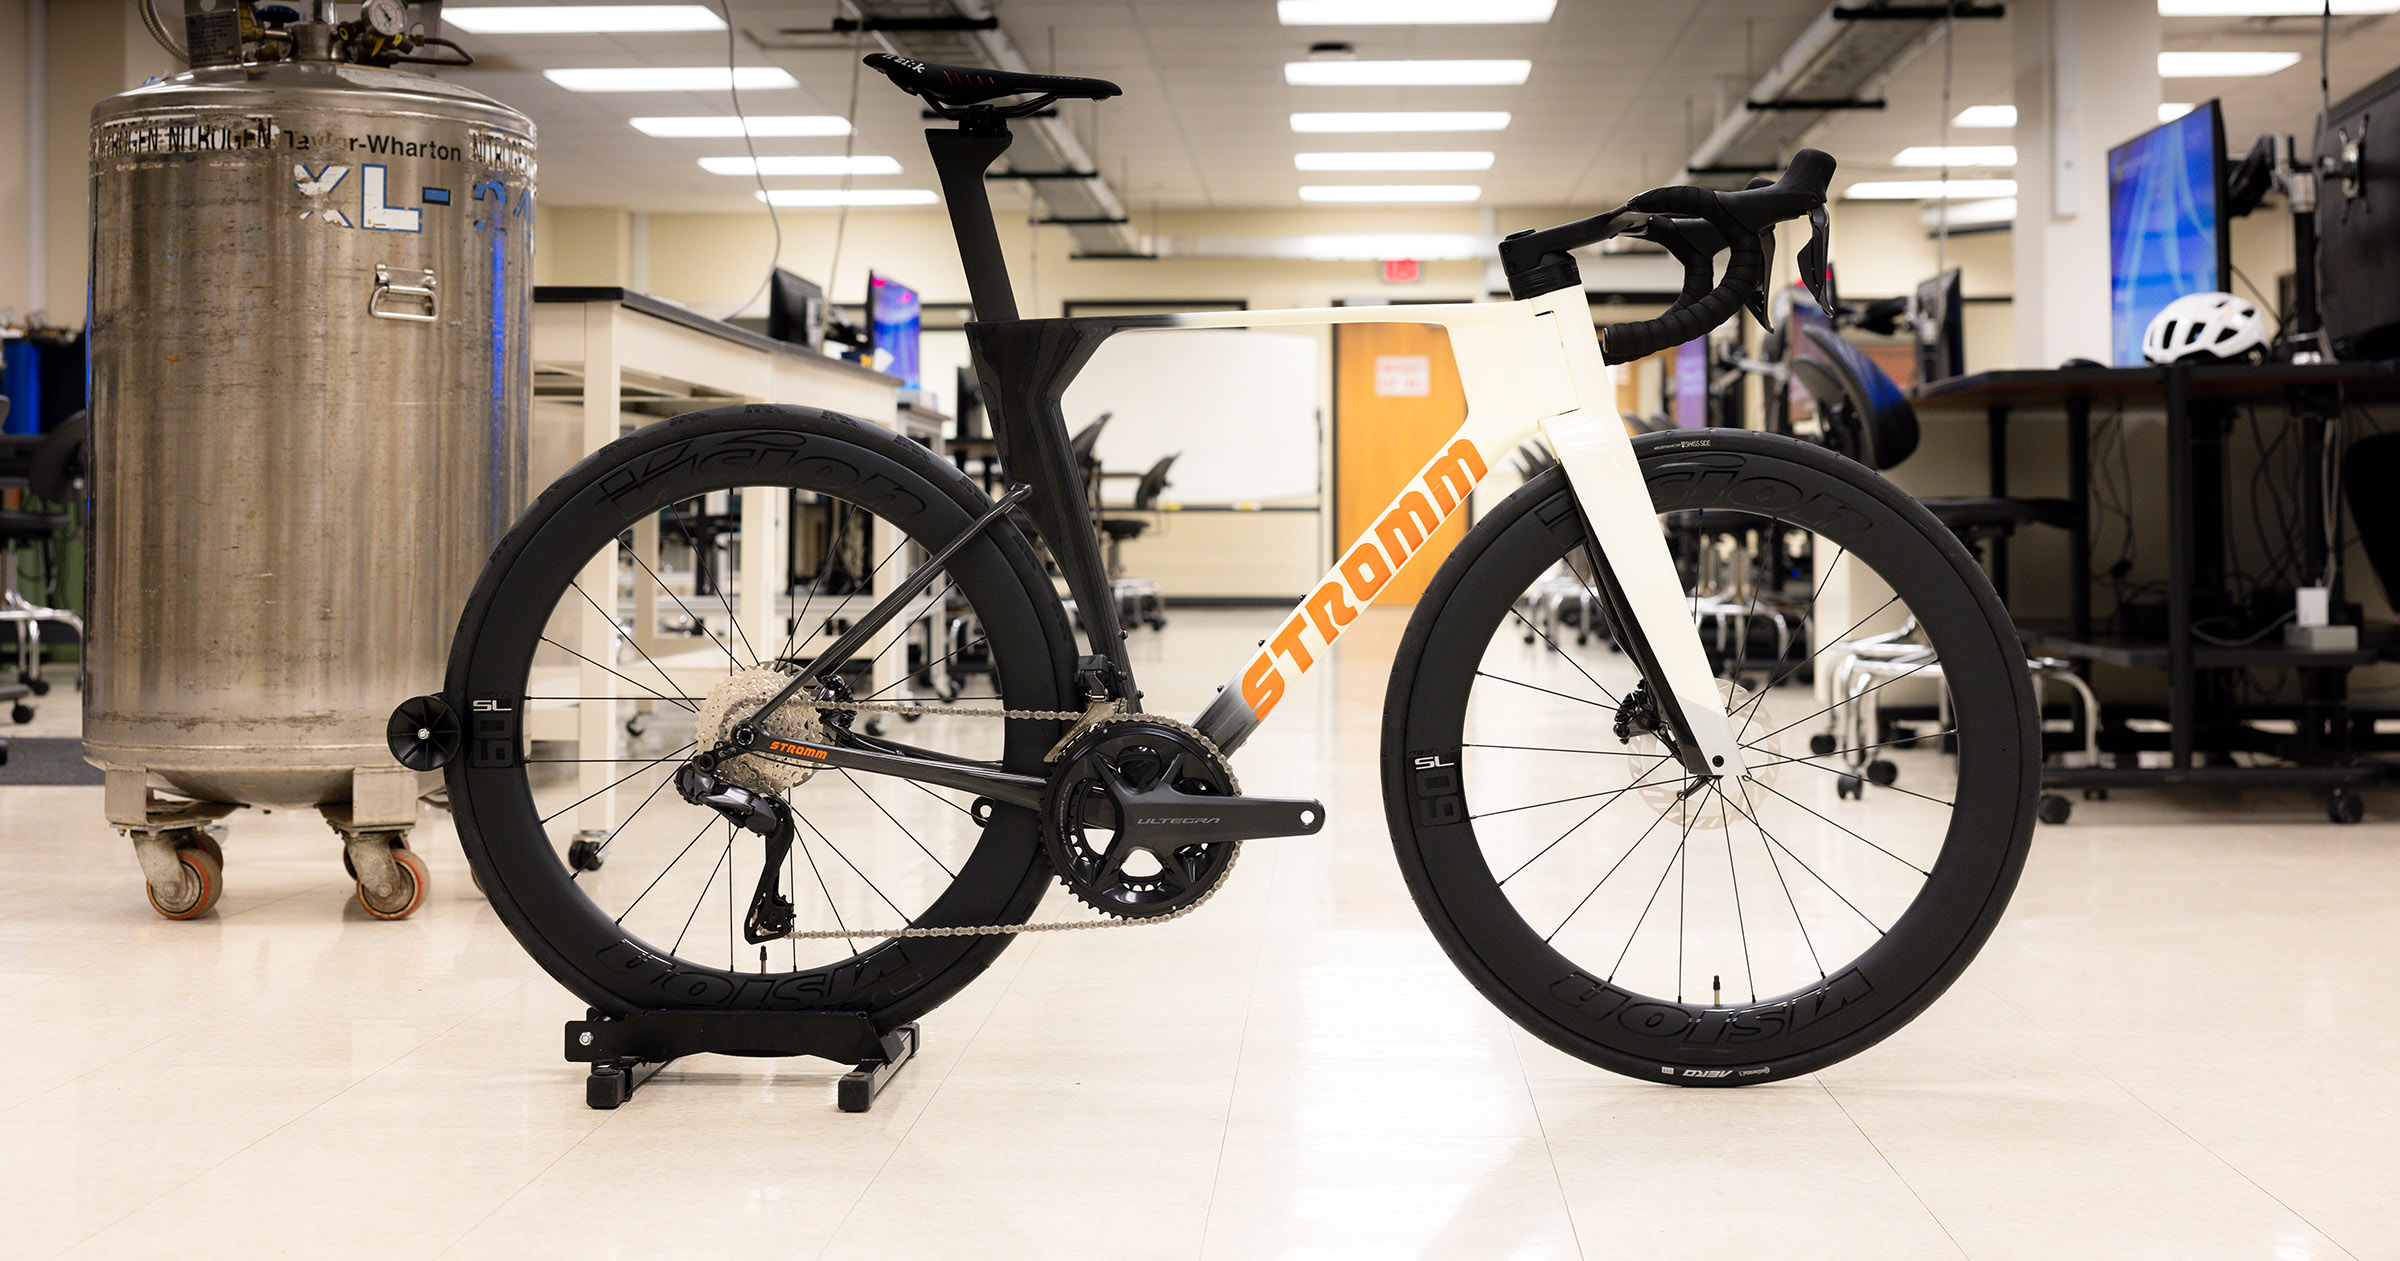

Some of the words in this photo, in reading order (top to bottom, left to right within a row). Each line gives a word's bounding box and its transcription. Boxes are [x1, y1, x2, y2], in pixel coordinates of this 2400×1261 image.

[283, 130, 462, 162] Tar-Wharton
[1241, 438, 1488, 722] STROMM
[472, 700, 513, 711] SL
[769, 741, 828, 760] STROMM
[1414, 756, 1455, 770] SL
[1137, 817, 1221, 825] ULTEGRA
[1682, 1064, 1734, 1078] AERO
